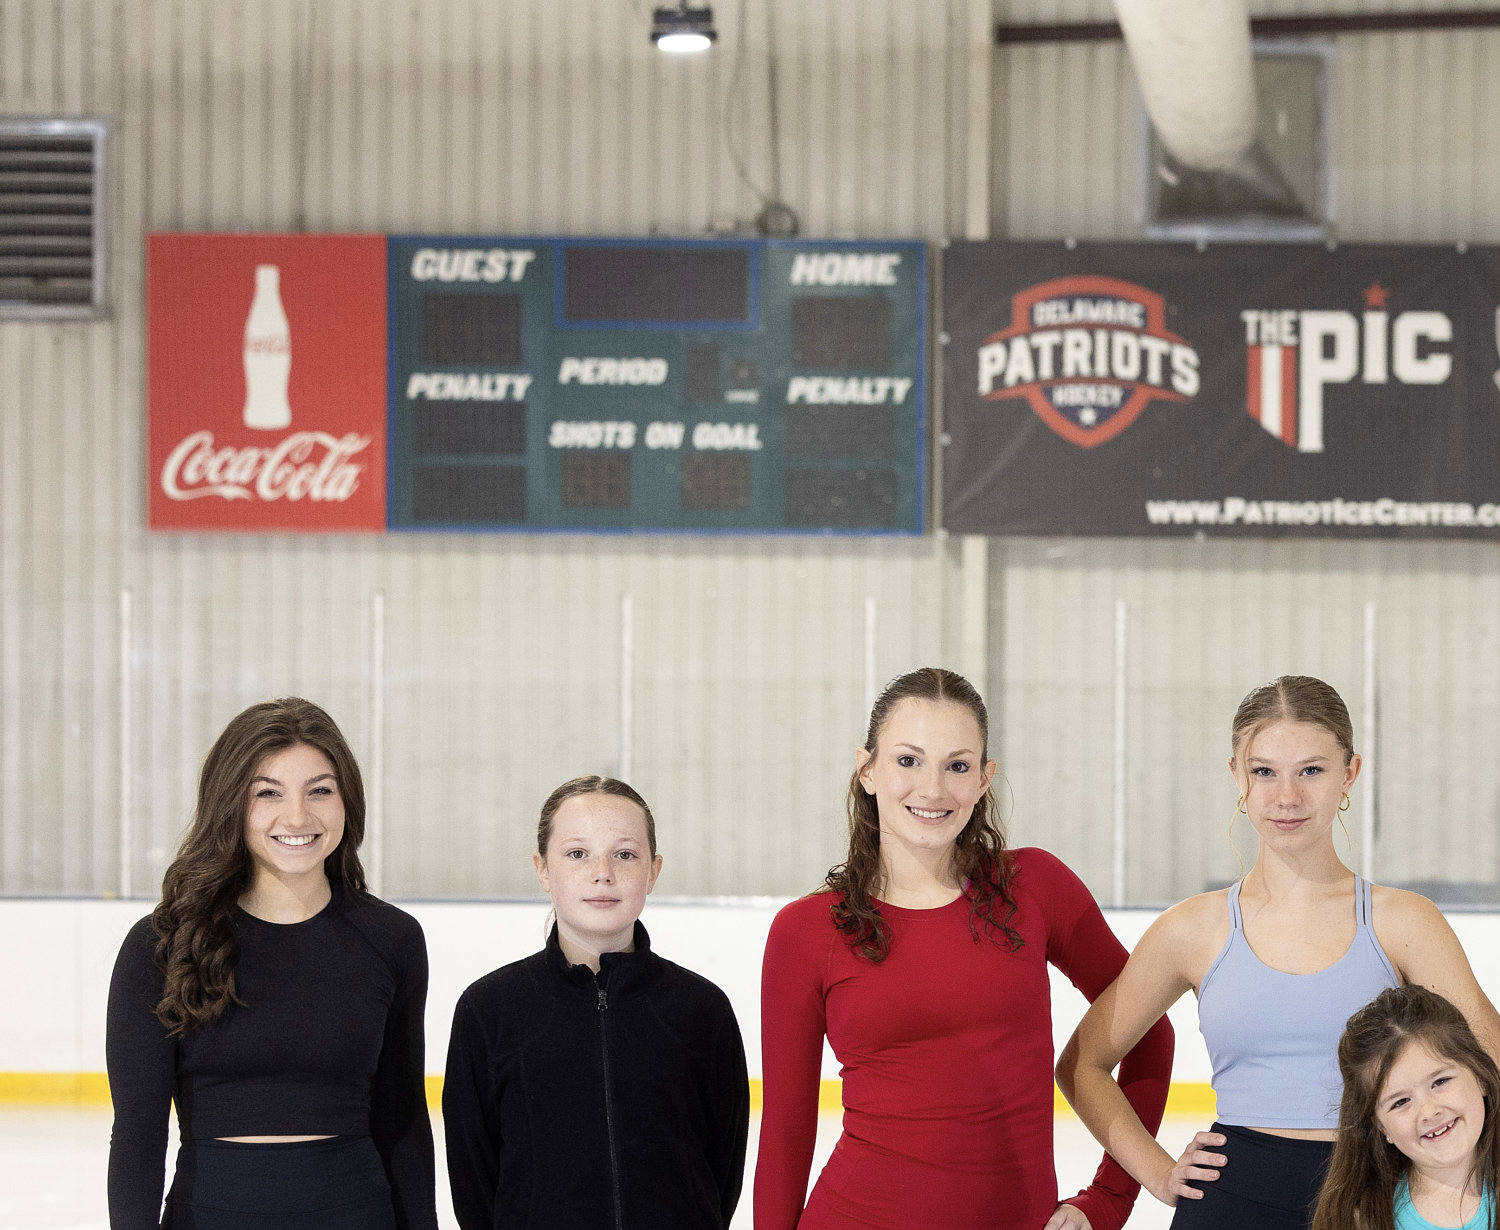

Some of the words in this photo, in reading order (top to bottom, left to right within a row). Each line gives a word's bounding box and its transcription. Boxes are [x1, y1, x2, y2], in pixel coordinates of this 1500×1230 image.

[411, 249, 536, 282] GUEST
[790, 253, 901, 286] HOME
[1032, 298, 1146, 327] DELAWARE
[1241, 310, 1299, 346] THE
[559, 357, 668, 386] PERIOD
[977, 328, 1200, 397] PATRIOTS
[407, 372, 533, 401] PENALTY
[786, 376, 912, 404] PENALTY
[548, 421, 637, 449] SHOTS
[644, 422, 686, 450] ON
[692, 423, 762, 450] GOAL
